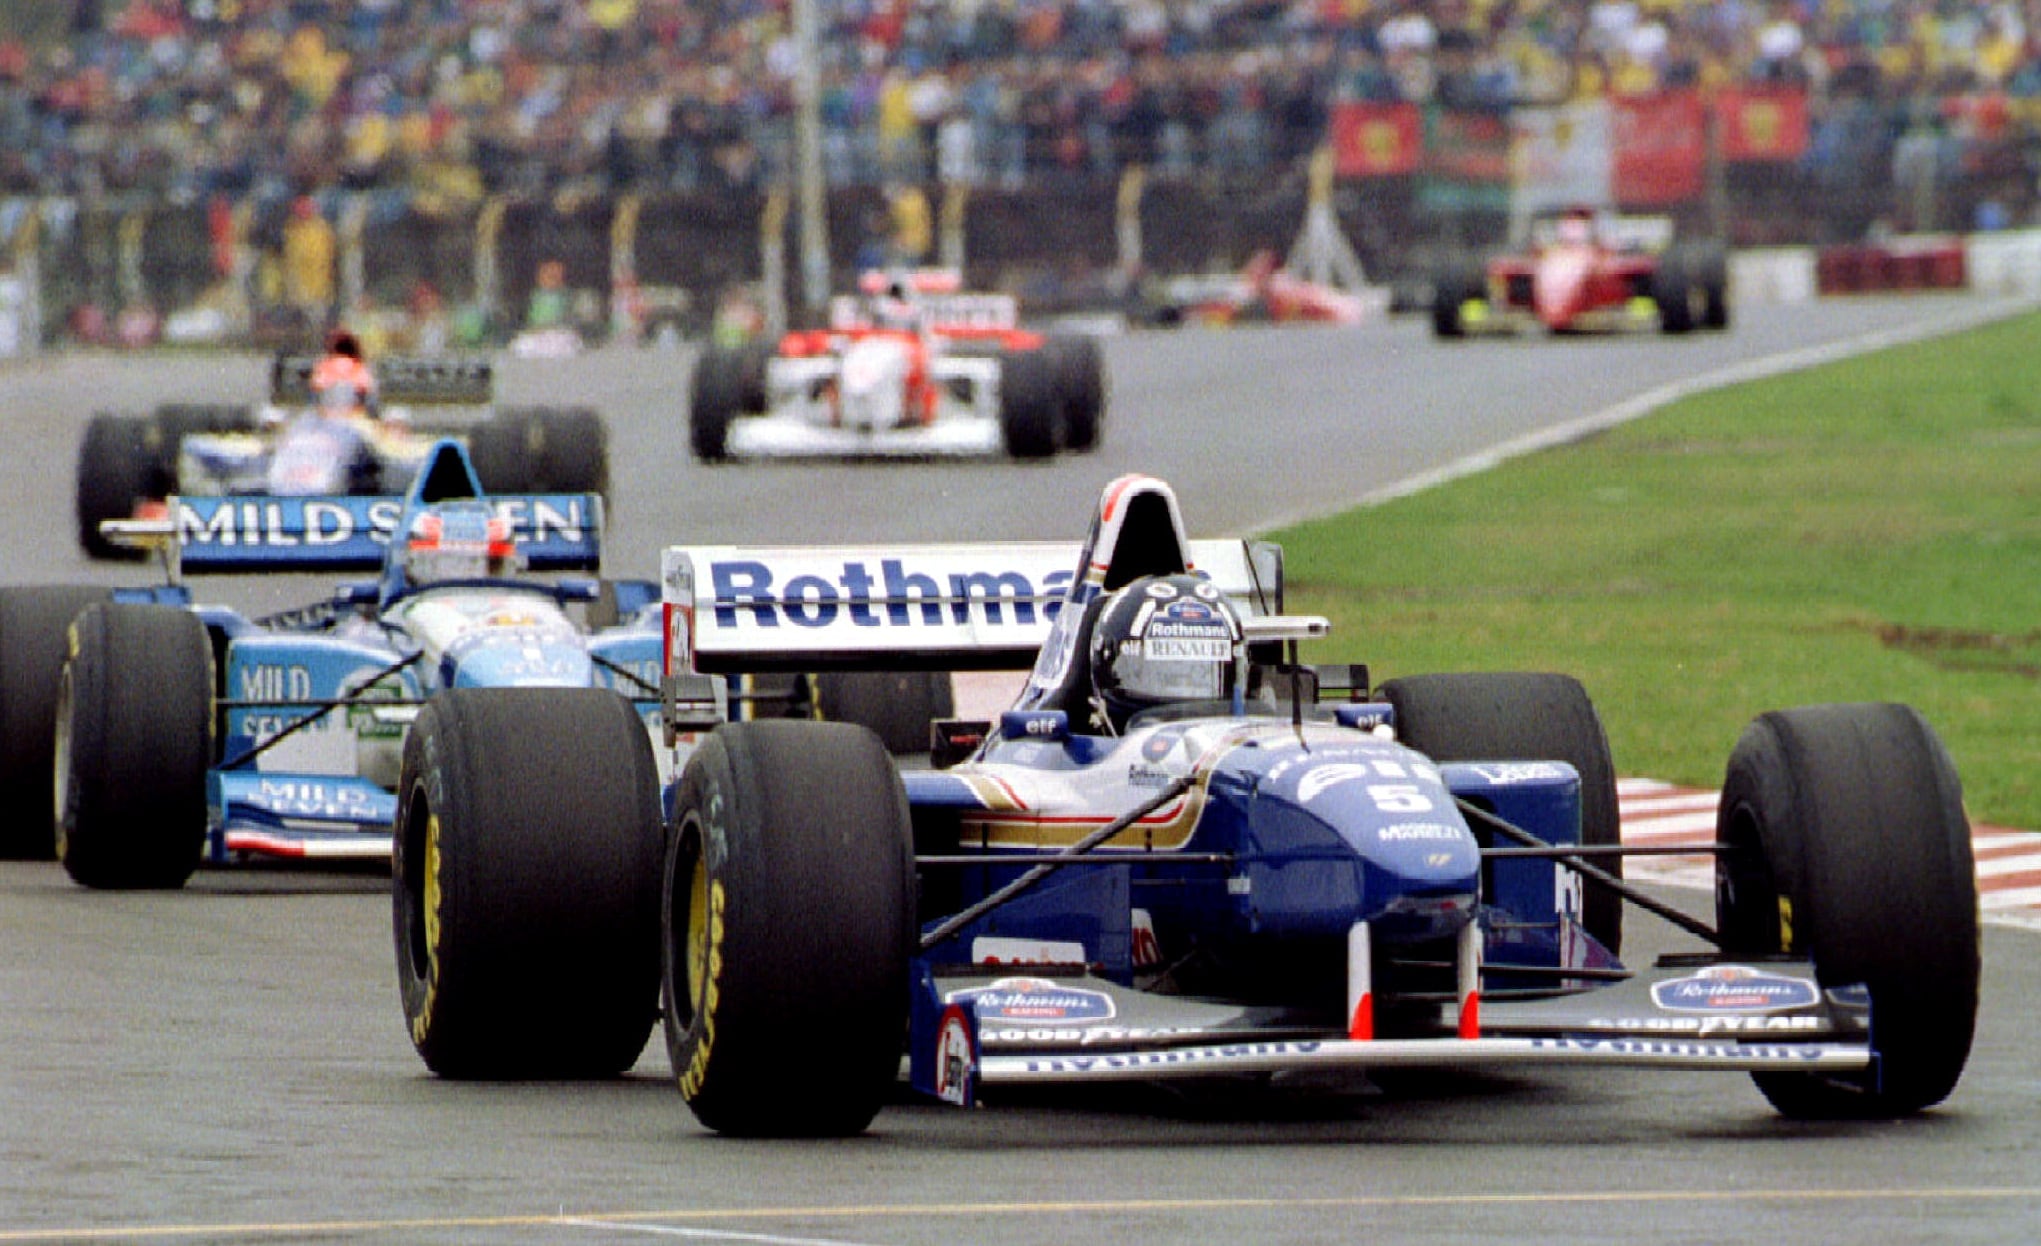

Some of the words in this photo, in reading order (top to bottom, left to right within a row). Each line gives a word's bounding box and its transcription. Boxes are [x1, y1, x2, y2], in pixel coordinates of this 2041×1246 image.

[179, 502, 353, 546] MILD
[369, 500, 582, 546] SEN
[711, 560, 1076, 628] Rothma
[1151, 641, 1225, 657] RENAULT
[241, 664, 311, 702] MILD
[1025, 709, 1057, 733] elf
[1366, 784, 1434, 813] 5
